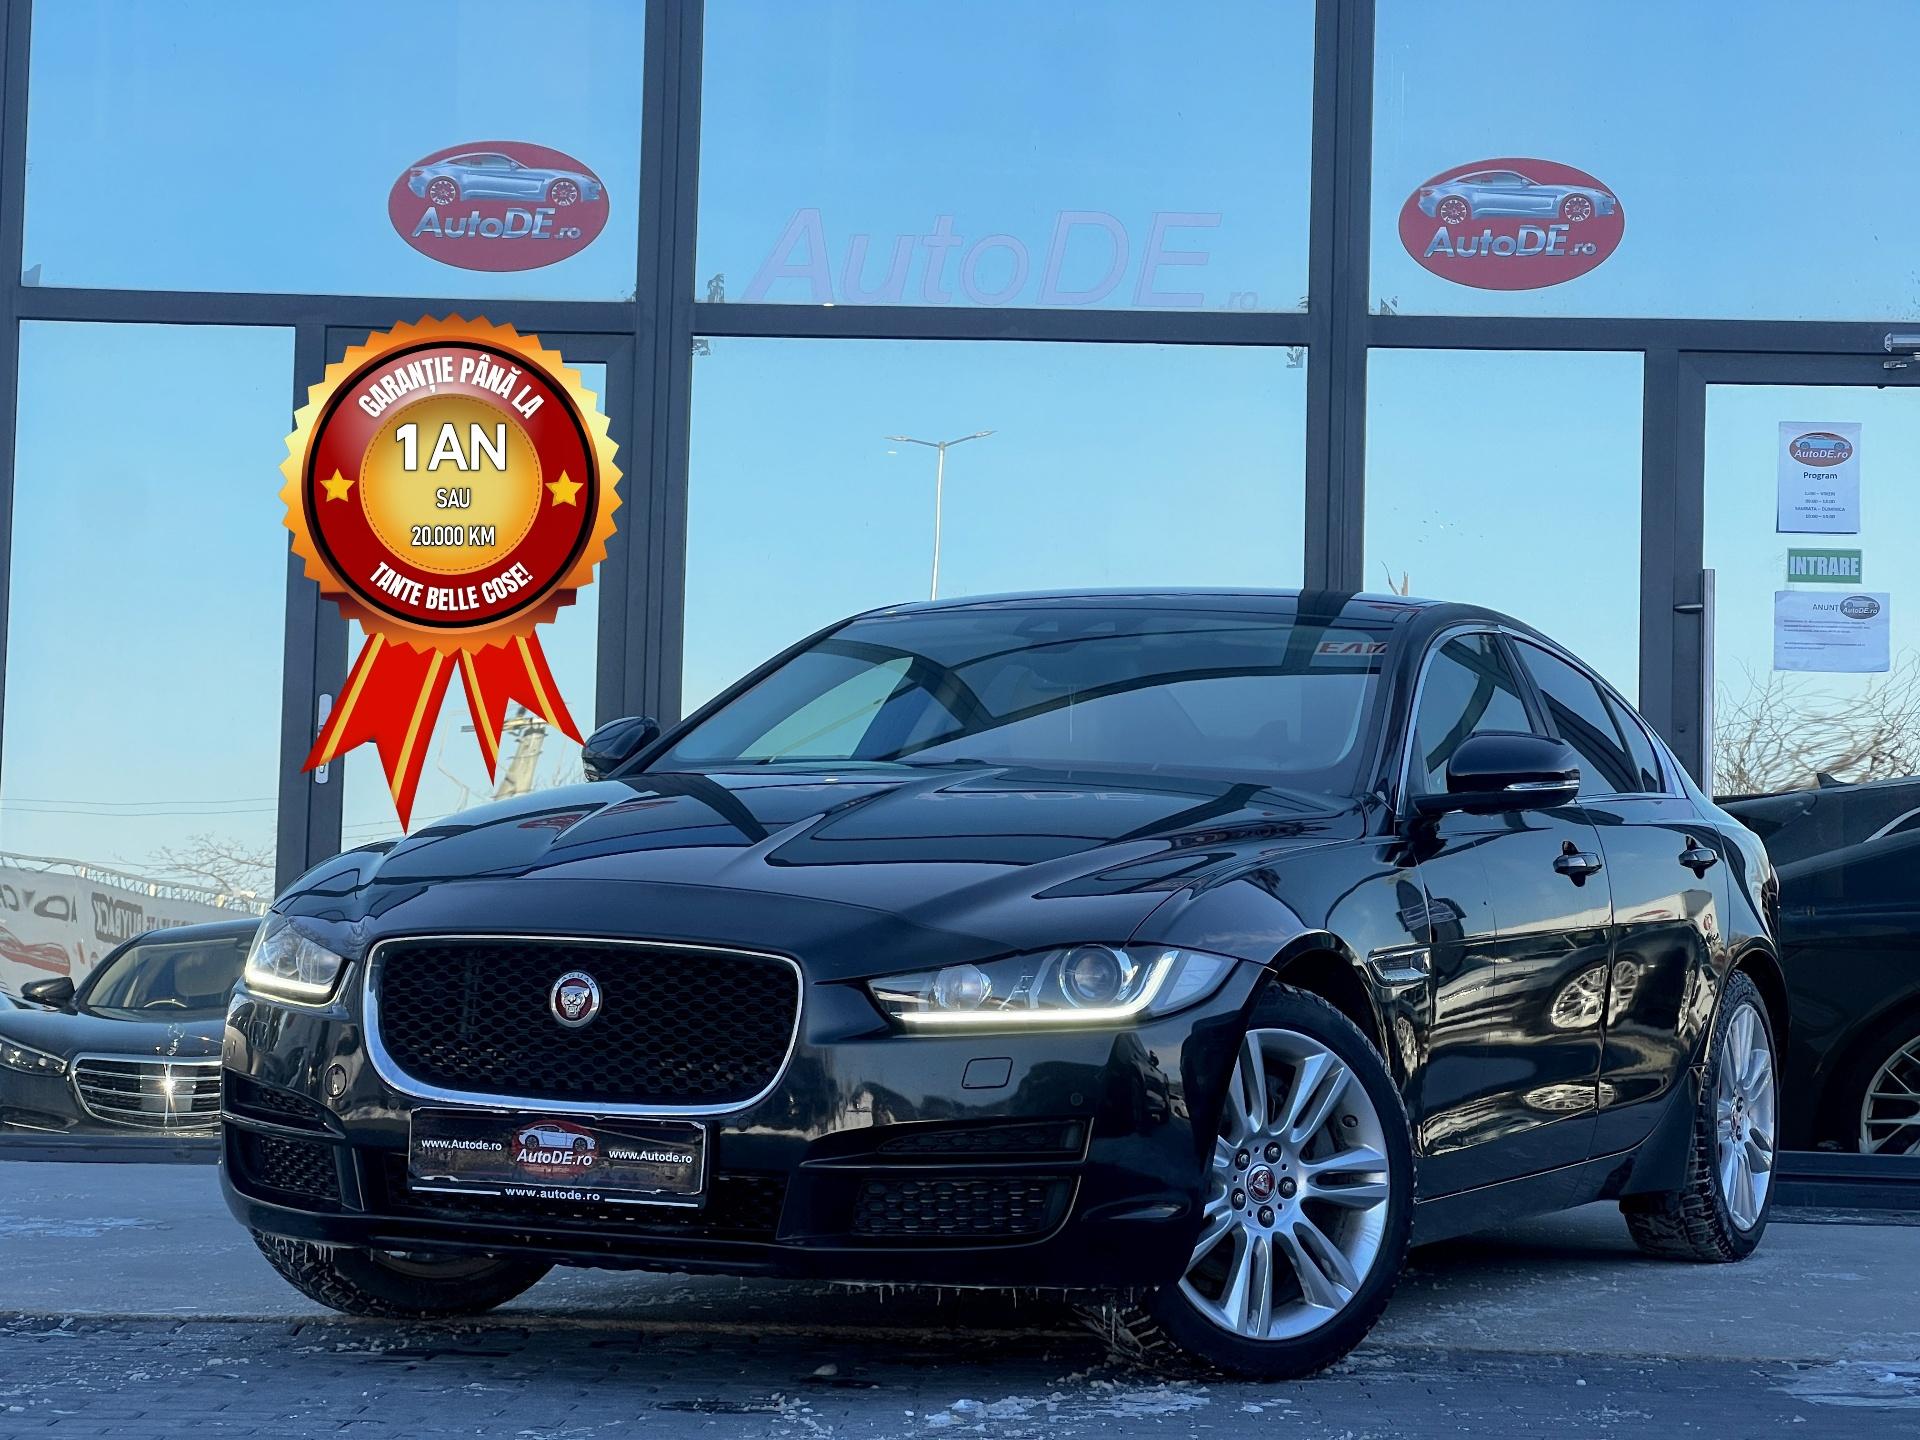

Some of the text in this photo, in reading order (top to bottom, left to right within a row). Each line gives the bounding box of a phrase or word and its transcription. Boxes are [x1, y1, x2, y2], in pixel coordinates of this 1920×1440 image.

[1803, 471, 1838, 480] Program
[1789, 555, 1860, 576] INTRARE
[421, 1138, 503, 1152] www.Autode.ro
[516, 1148, 593, 1167] AutoDE.ro
[608, 1149, 693, 1164] www.Autode.ro
[504, 1187, 601, 1202] www.autode.ro
